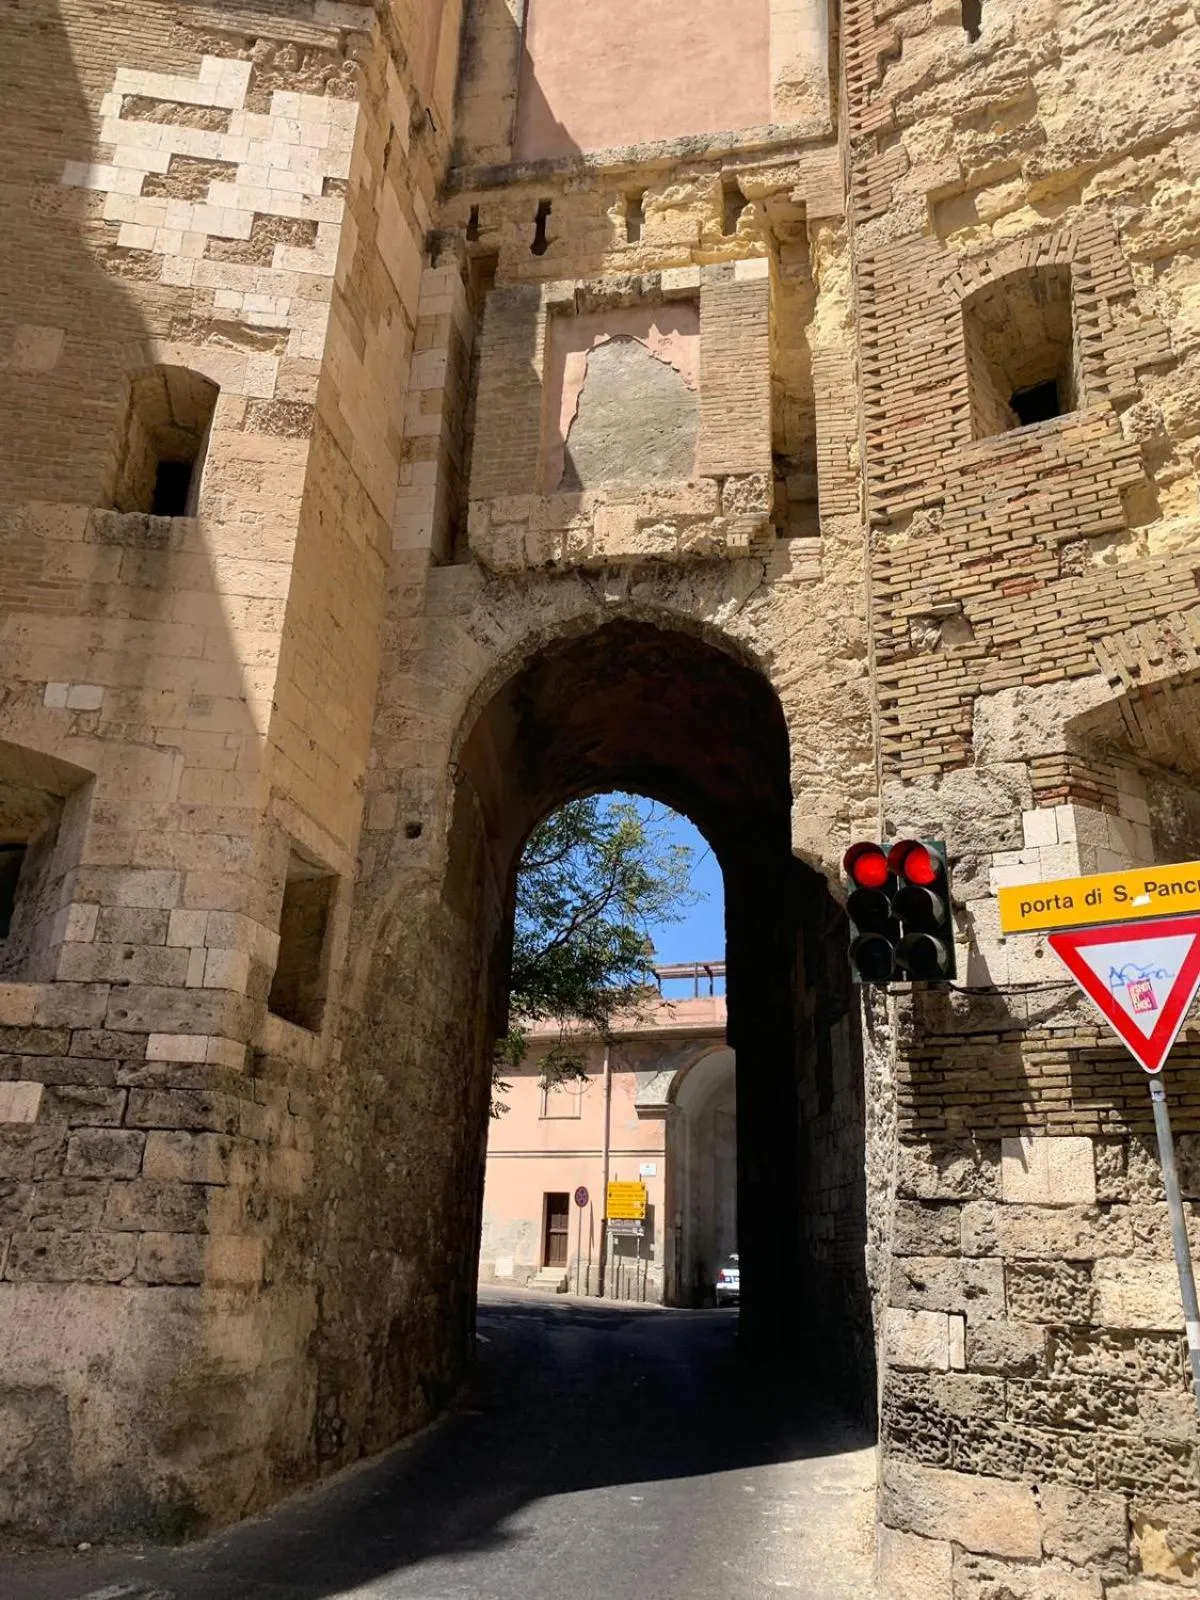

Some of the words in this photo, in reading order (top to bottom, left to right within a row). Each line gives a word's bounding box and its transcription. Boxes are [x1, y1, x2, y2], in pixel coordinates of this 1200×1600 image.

[1020, 894, 1073, 918] porta
[1085, 888, 1102, 906] di
[1113, 884, 1134, 903] S.
